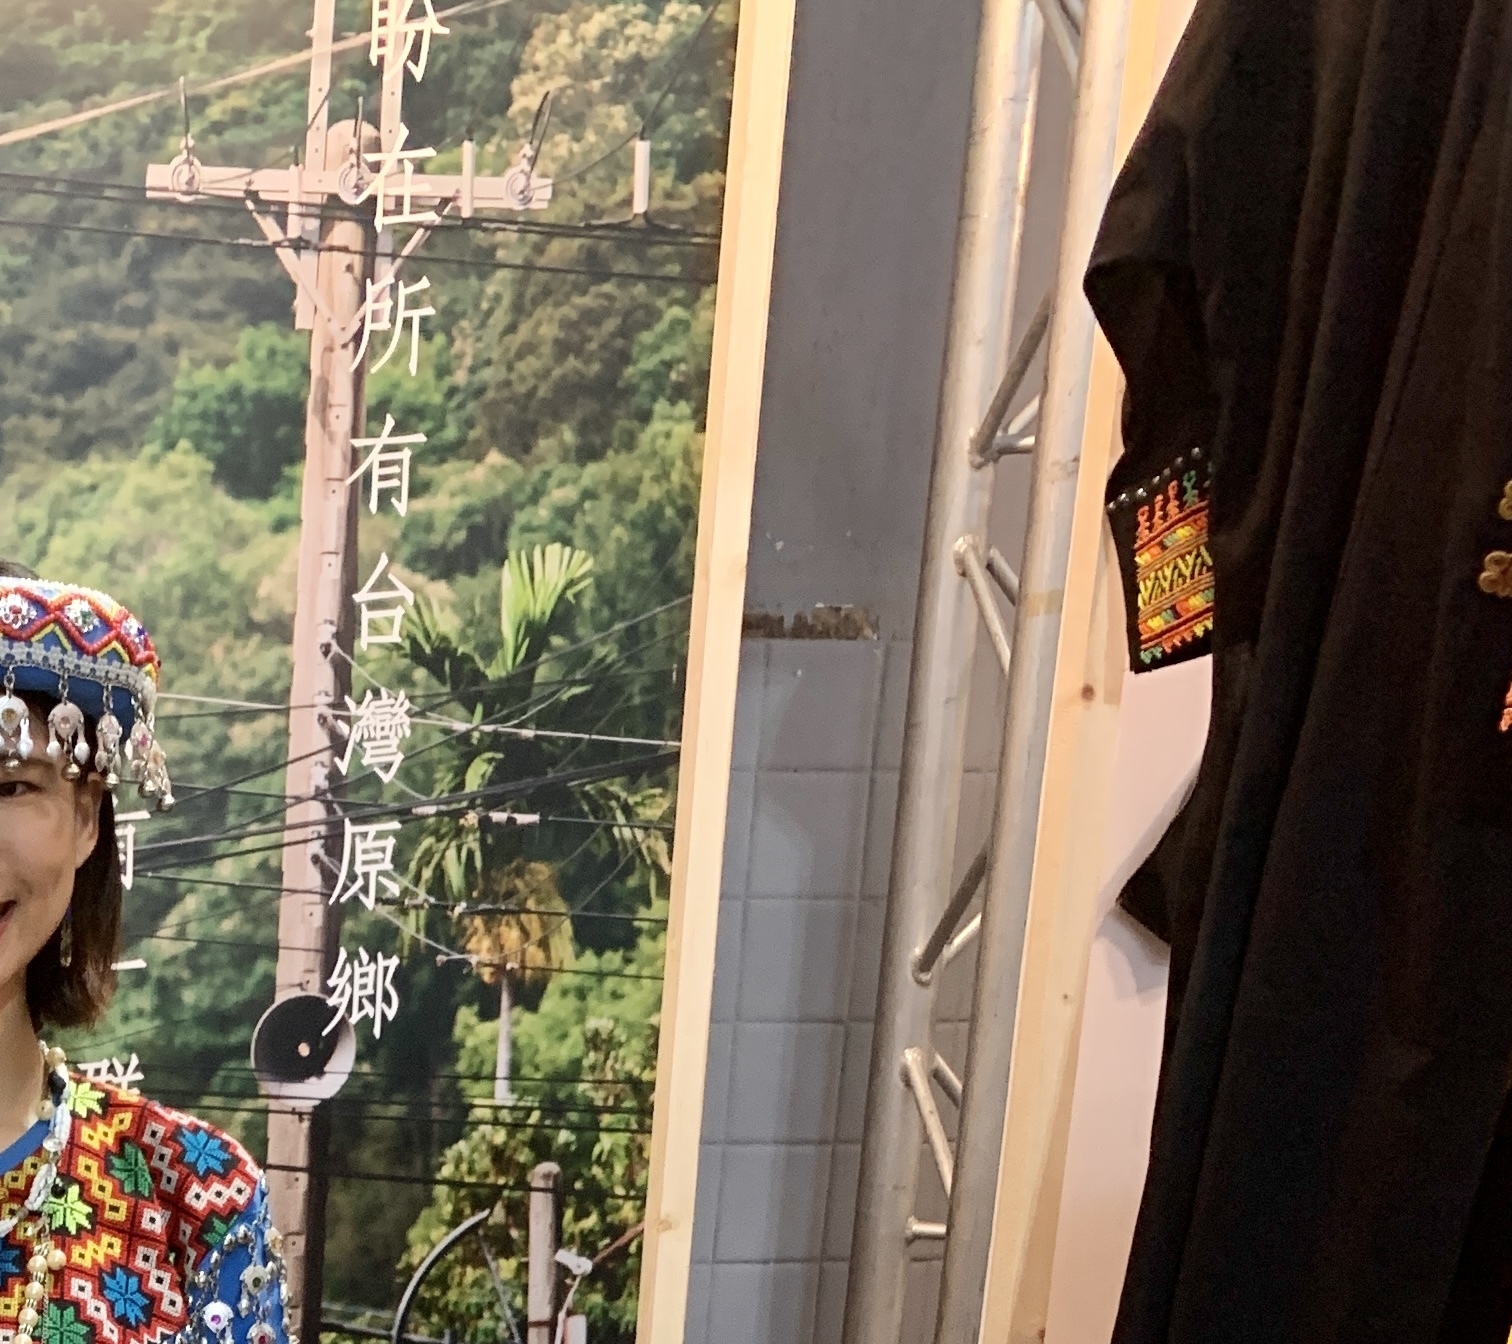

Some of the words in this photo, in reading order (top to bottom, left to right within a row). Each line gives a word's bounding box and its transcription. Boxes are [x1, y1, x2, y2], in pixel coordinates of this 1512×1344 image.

[323, 0, 449, 1038] 盼在所有台灣原鄉
